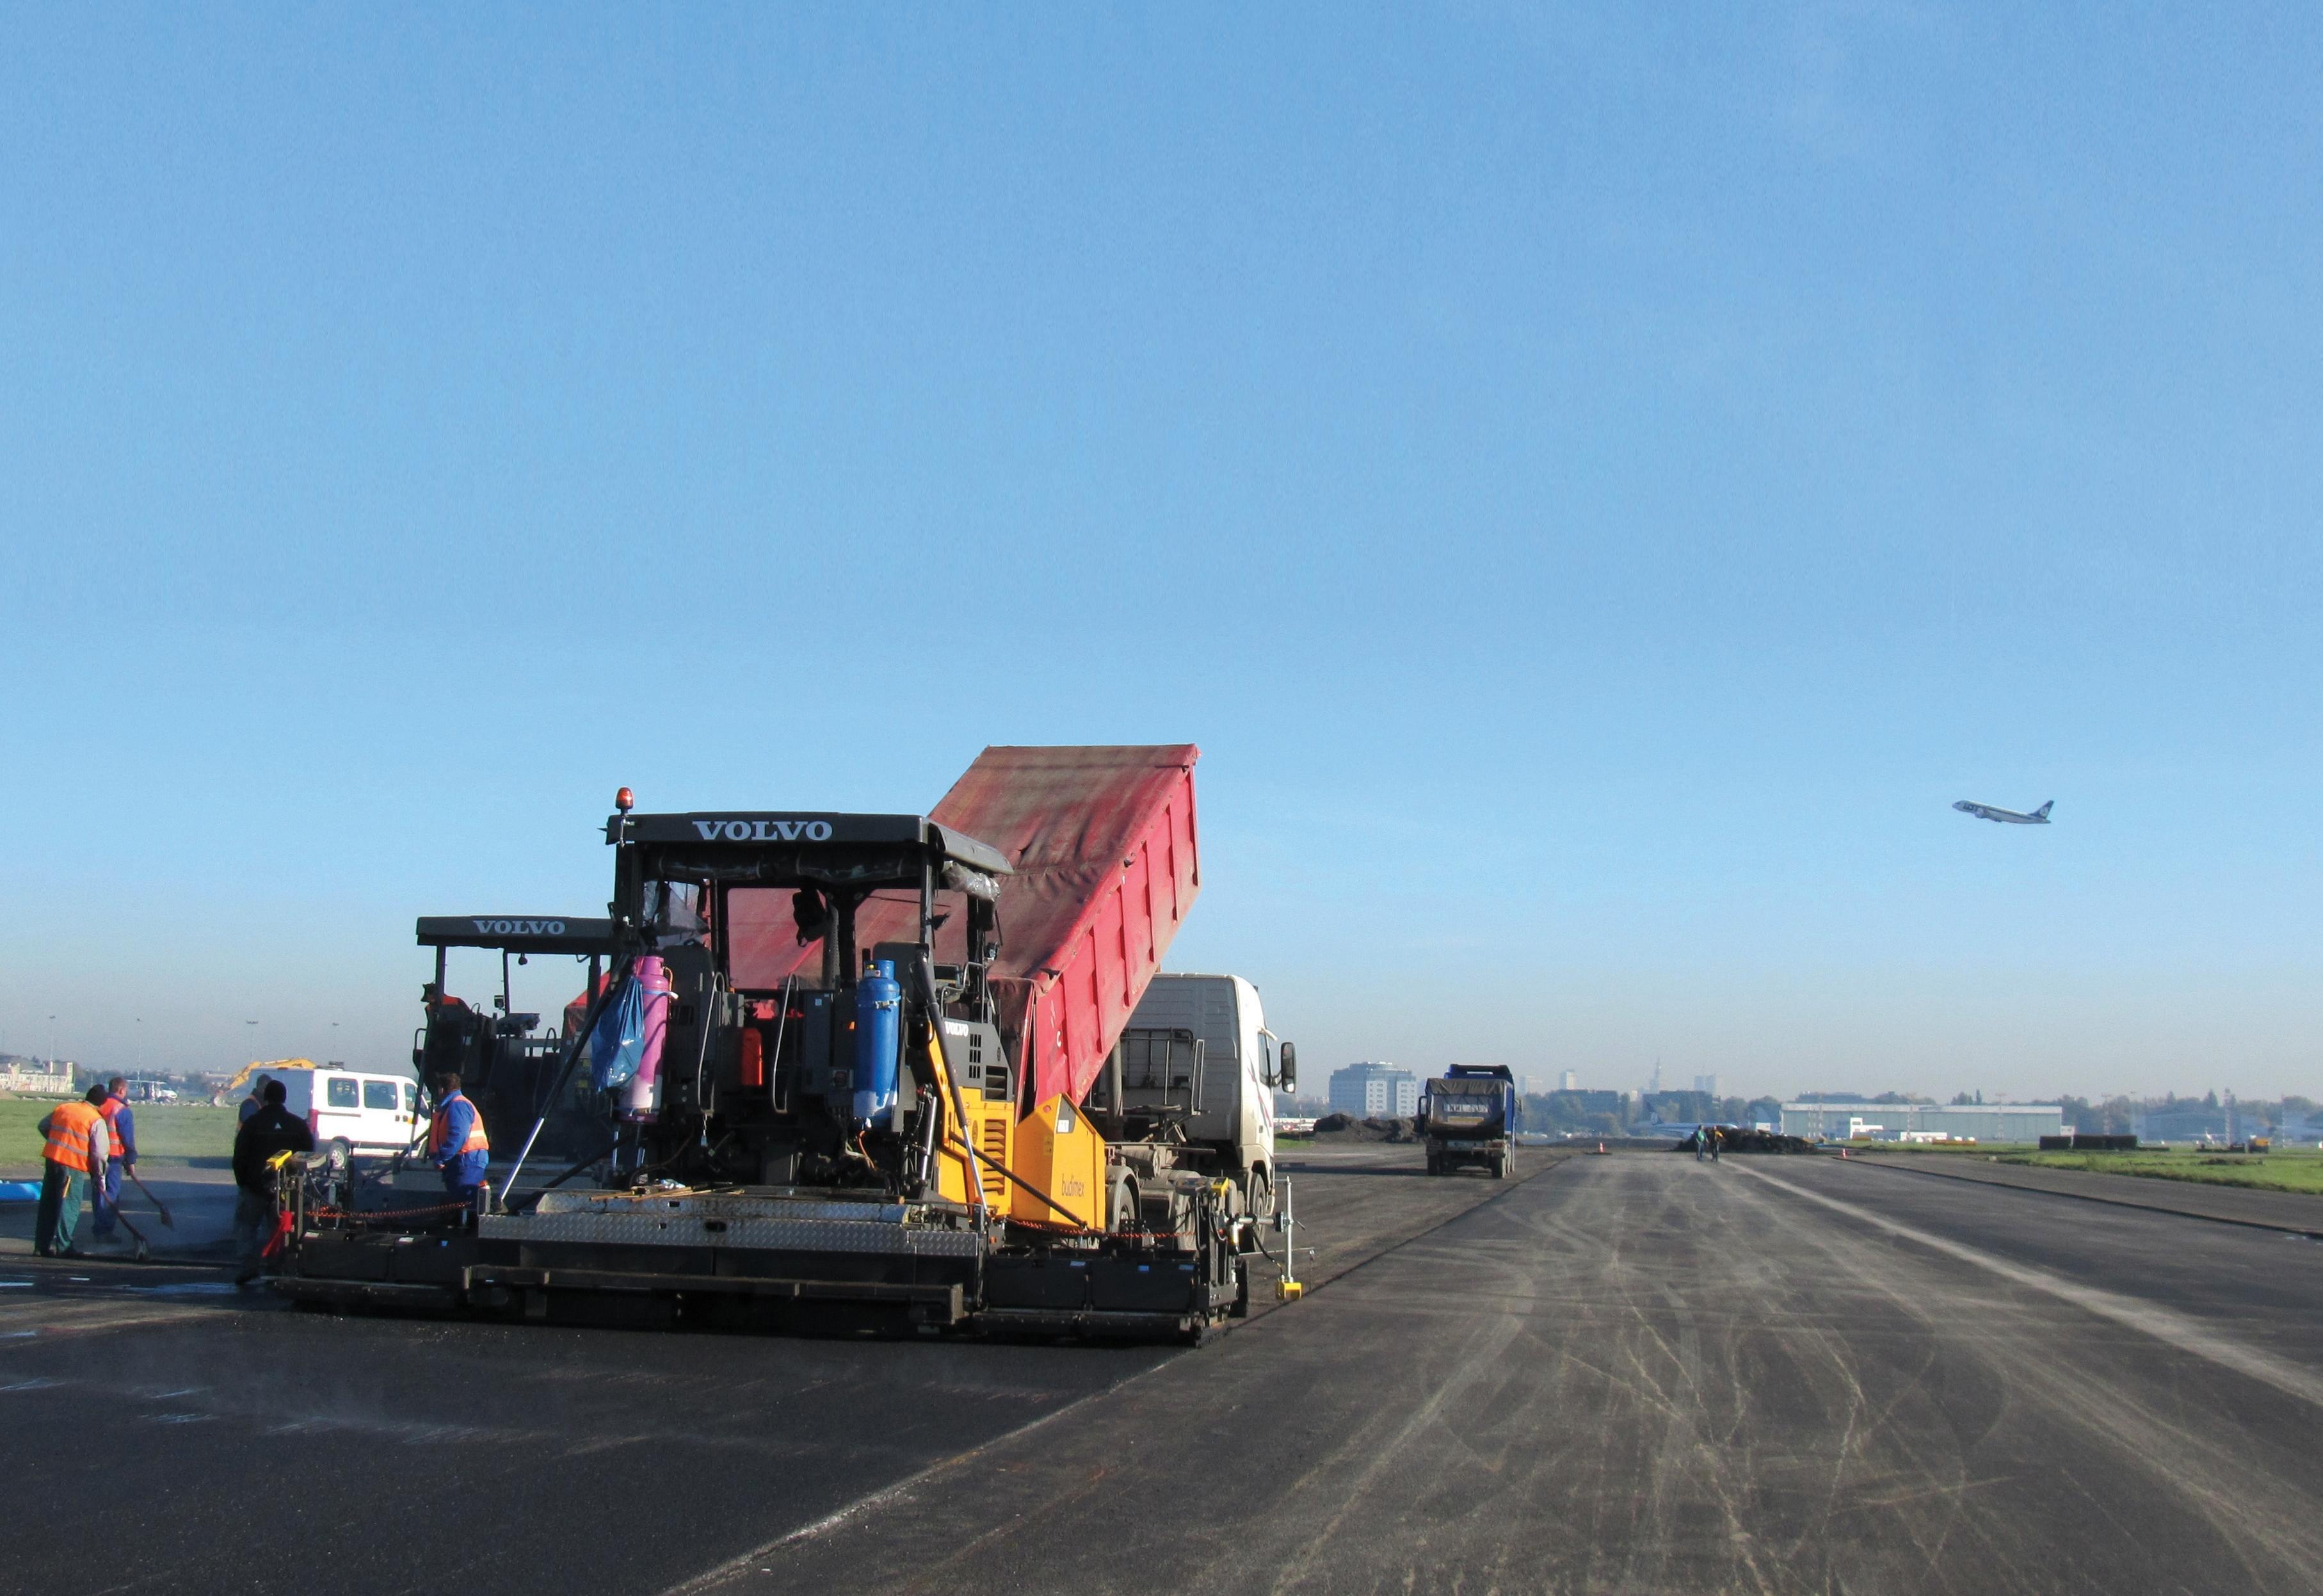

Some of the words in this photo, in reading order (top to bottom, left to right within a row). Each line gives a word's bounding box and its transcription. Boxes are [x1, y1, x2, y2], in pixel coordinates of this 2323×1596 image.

[692, 821, 832, 841] VOLVO
[473, 920, 565, 935] VOLVO
[944, 1021, 969, 1036] VOLVO
[1061, 1173, 1085, 1197] budimex
